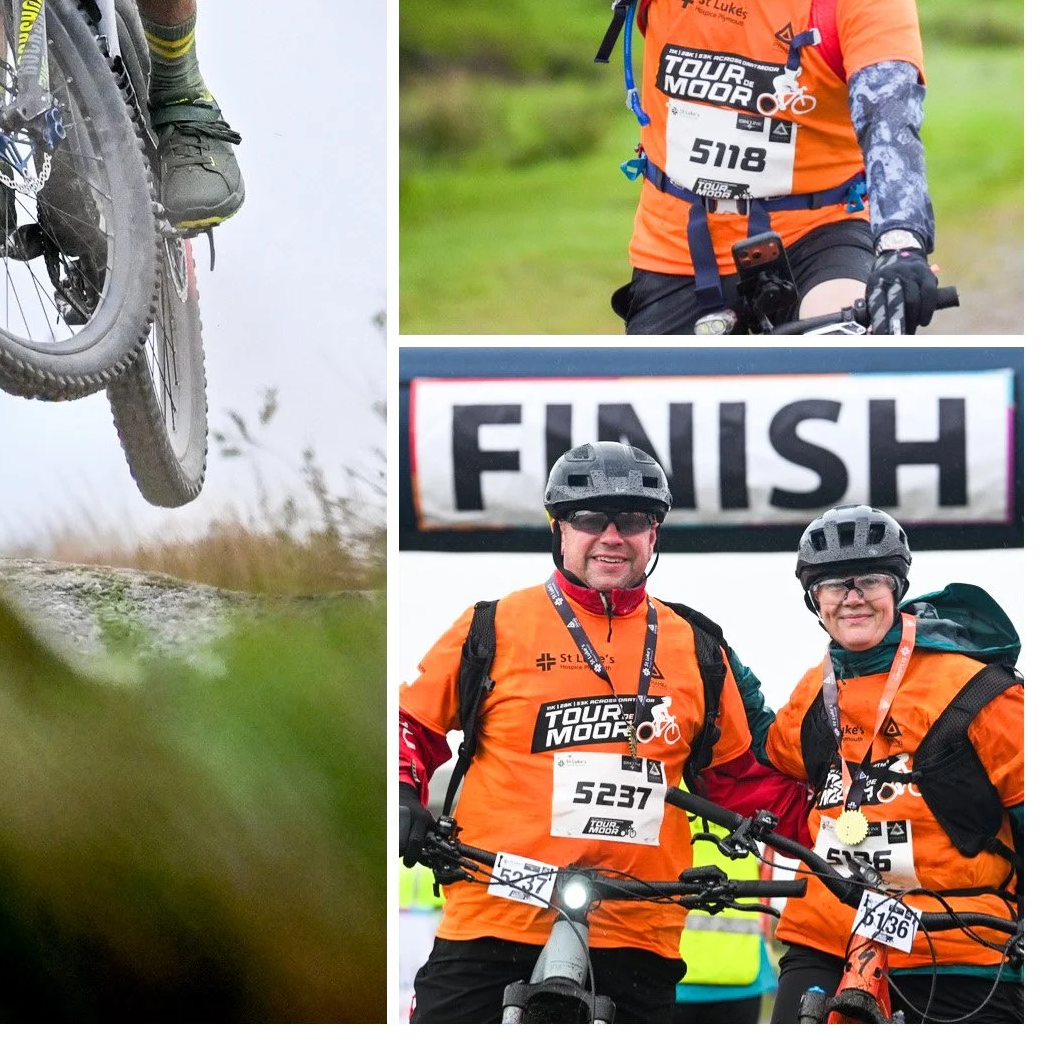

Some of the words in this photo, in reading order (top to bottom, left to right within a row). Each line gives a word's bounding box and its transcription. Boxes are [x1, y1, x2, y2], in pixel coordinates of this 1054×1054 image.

[665, 55, 746, 84] TOUR
[743, 79, 755, 88] DE
[713, 55, 741, 64] ACROSS
[742, 60, 780, 72] DARTMOOR
[664, 75, 754, 107] MOOR
[689, 137, 767, 173] 5118
[696, 189, 732, 199] MOOR
[697, 181, 728, 192] TOUR
[452, 397, 968, 512] FINISH
[560, 653, 572, 663] St
[546, 704, 624, 728] TOUR
[546, 722, 632, 747] MOOR
[573, 781, 652, 810] 5237
[588, 826, 619, 835] MOOR
[590, 820, 617, 828] TOUR
[499, 868, 548, 895] 5237
[864, 910, 909, 939] 5136
